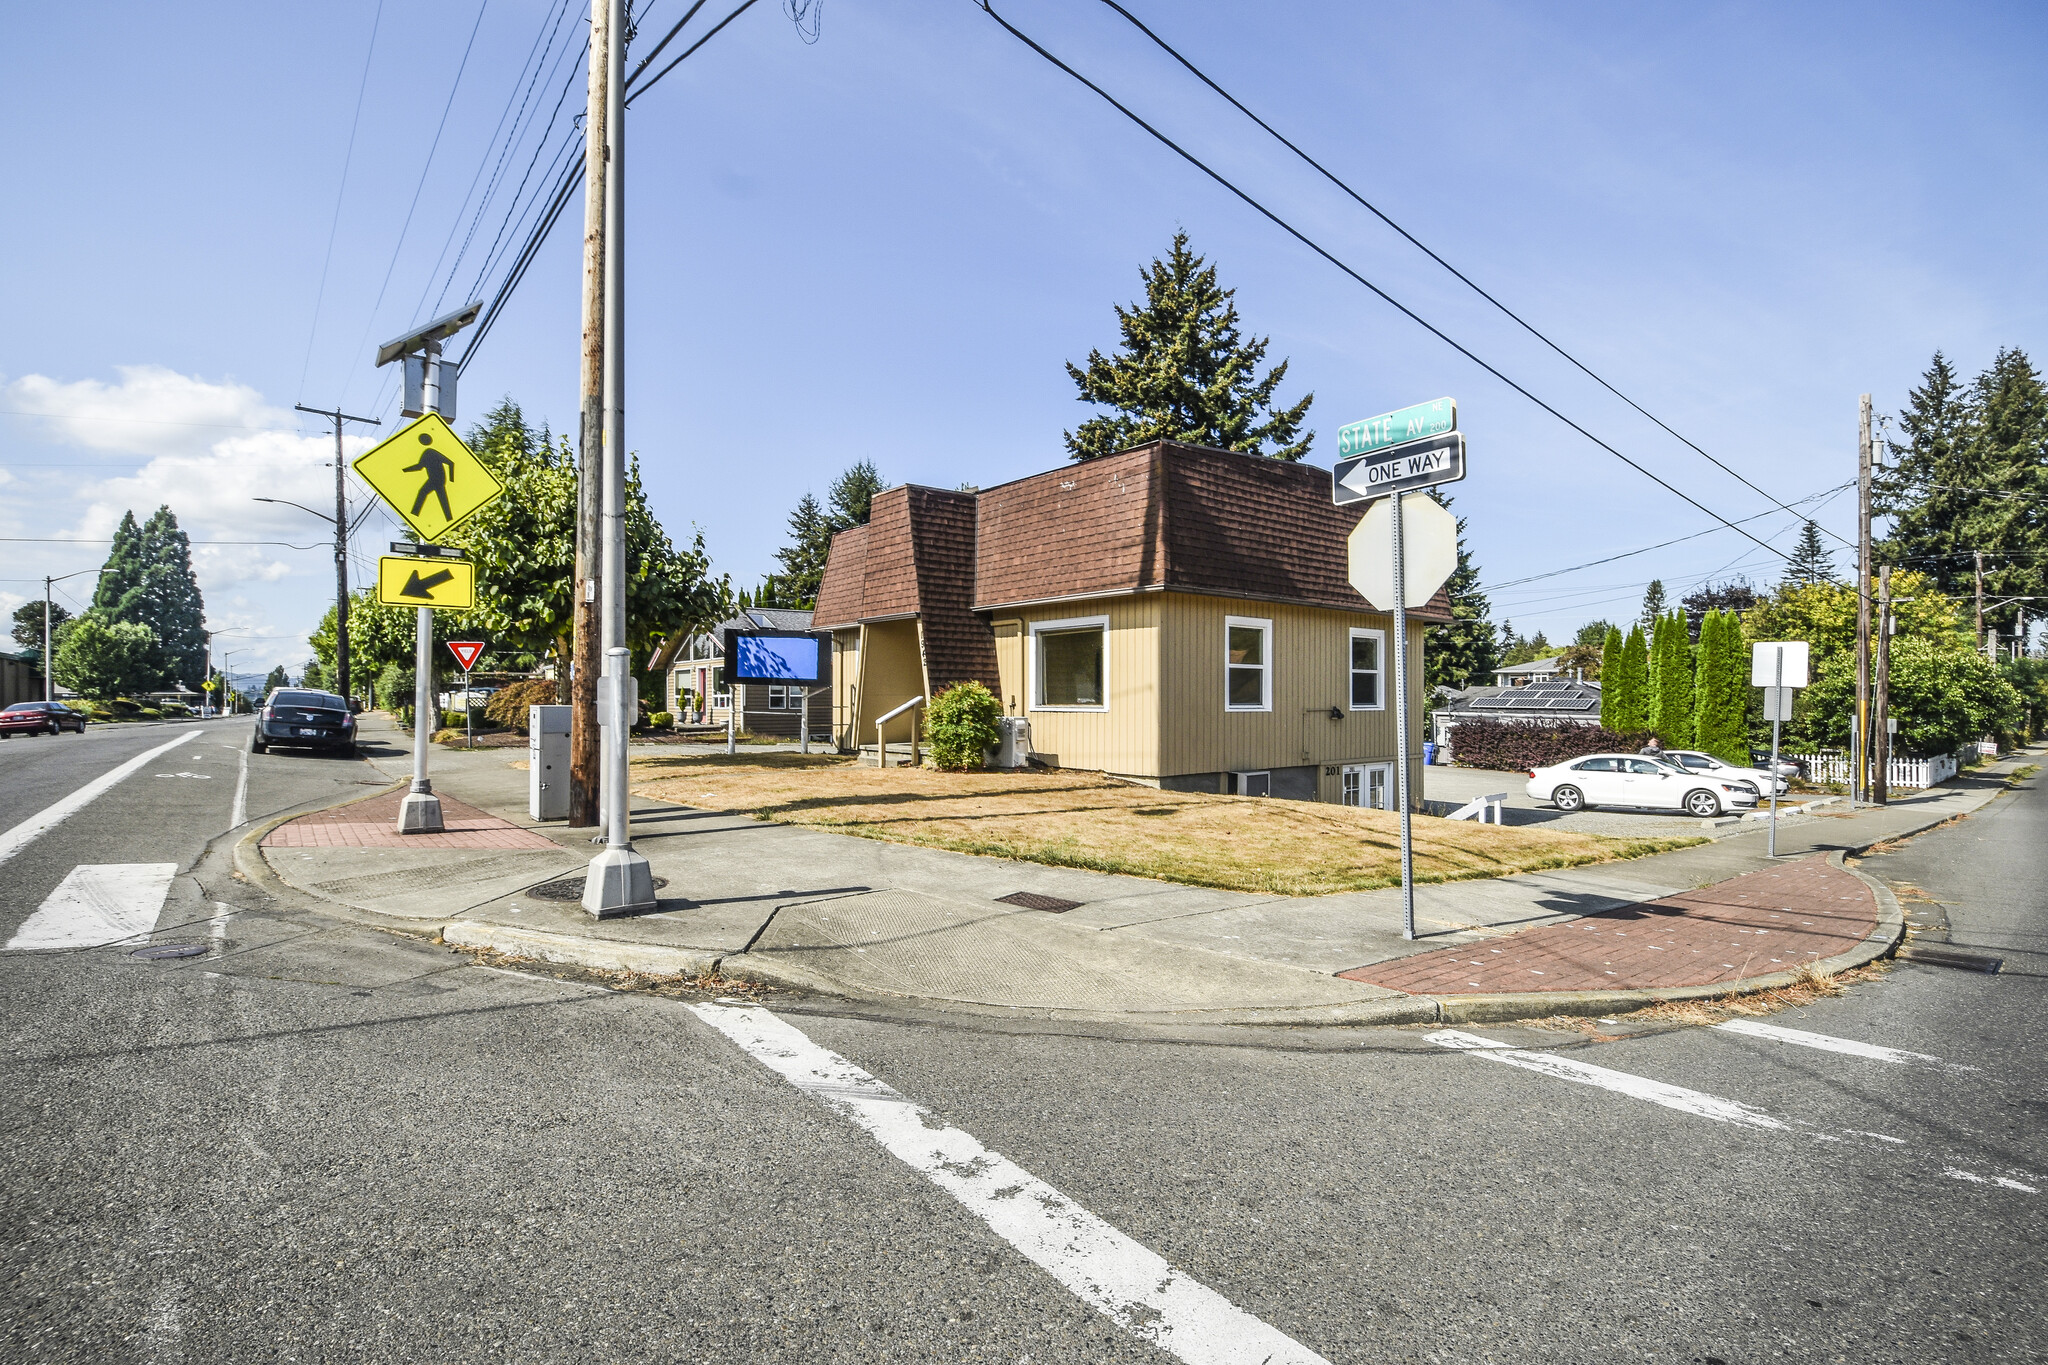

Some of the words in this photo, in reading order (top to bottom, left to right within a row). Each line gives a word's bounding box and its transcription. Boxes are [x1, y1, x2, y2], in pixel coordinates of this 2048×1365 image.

[1432, 401, 1443, 412] NE
[1429, 420, 1447, 433] 200
[1342, 417, 1393, 453] STATE
[1406, 416, 1424, 437] AV
[1369, 461, 1402, 483] ONE
[1408, 450, 1444, 475] WAY
[1326, 767, 1340, 775] 201
